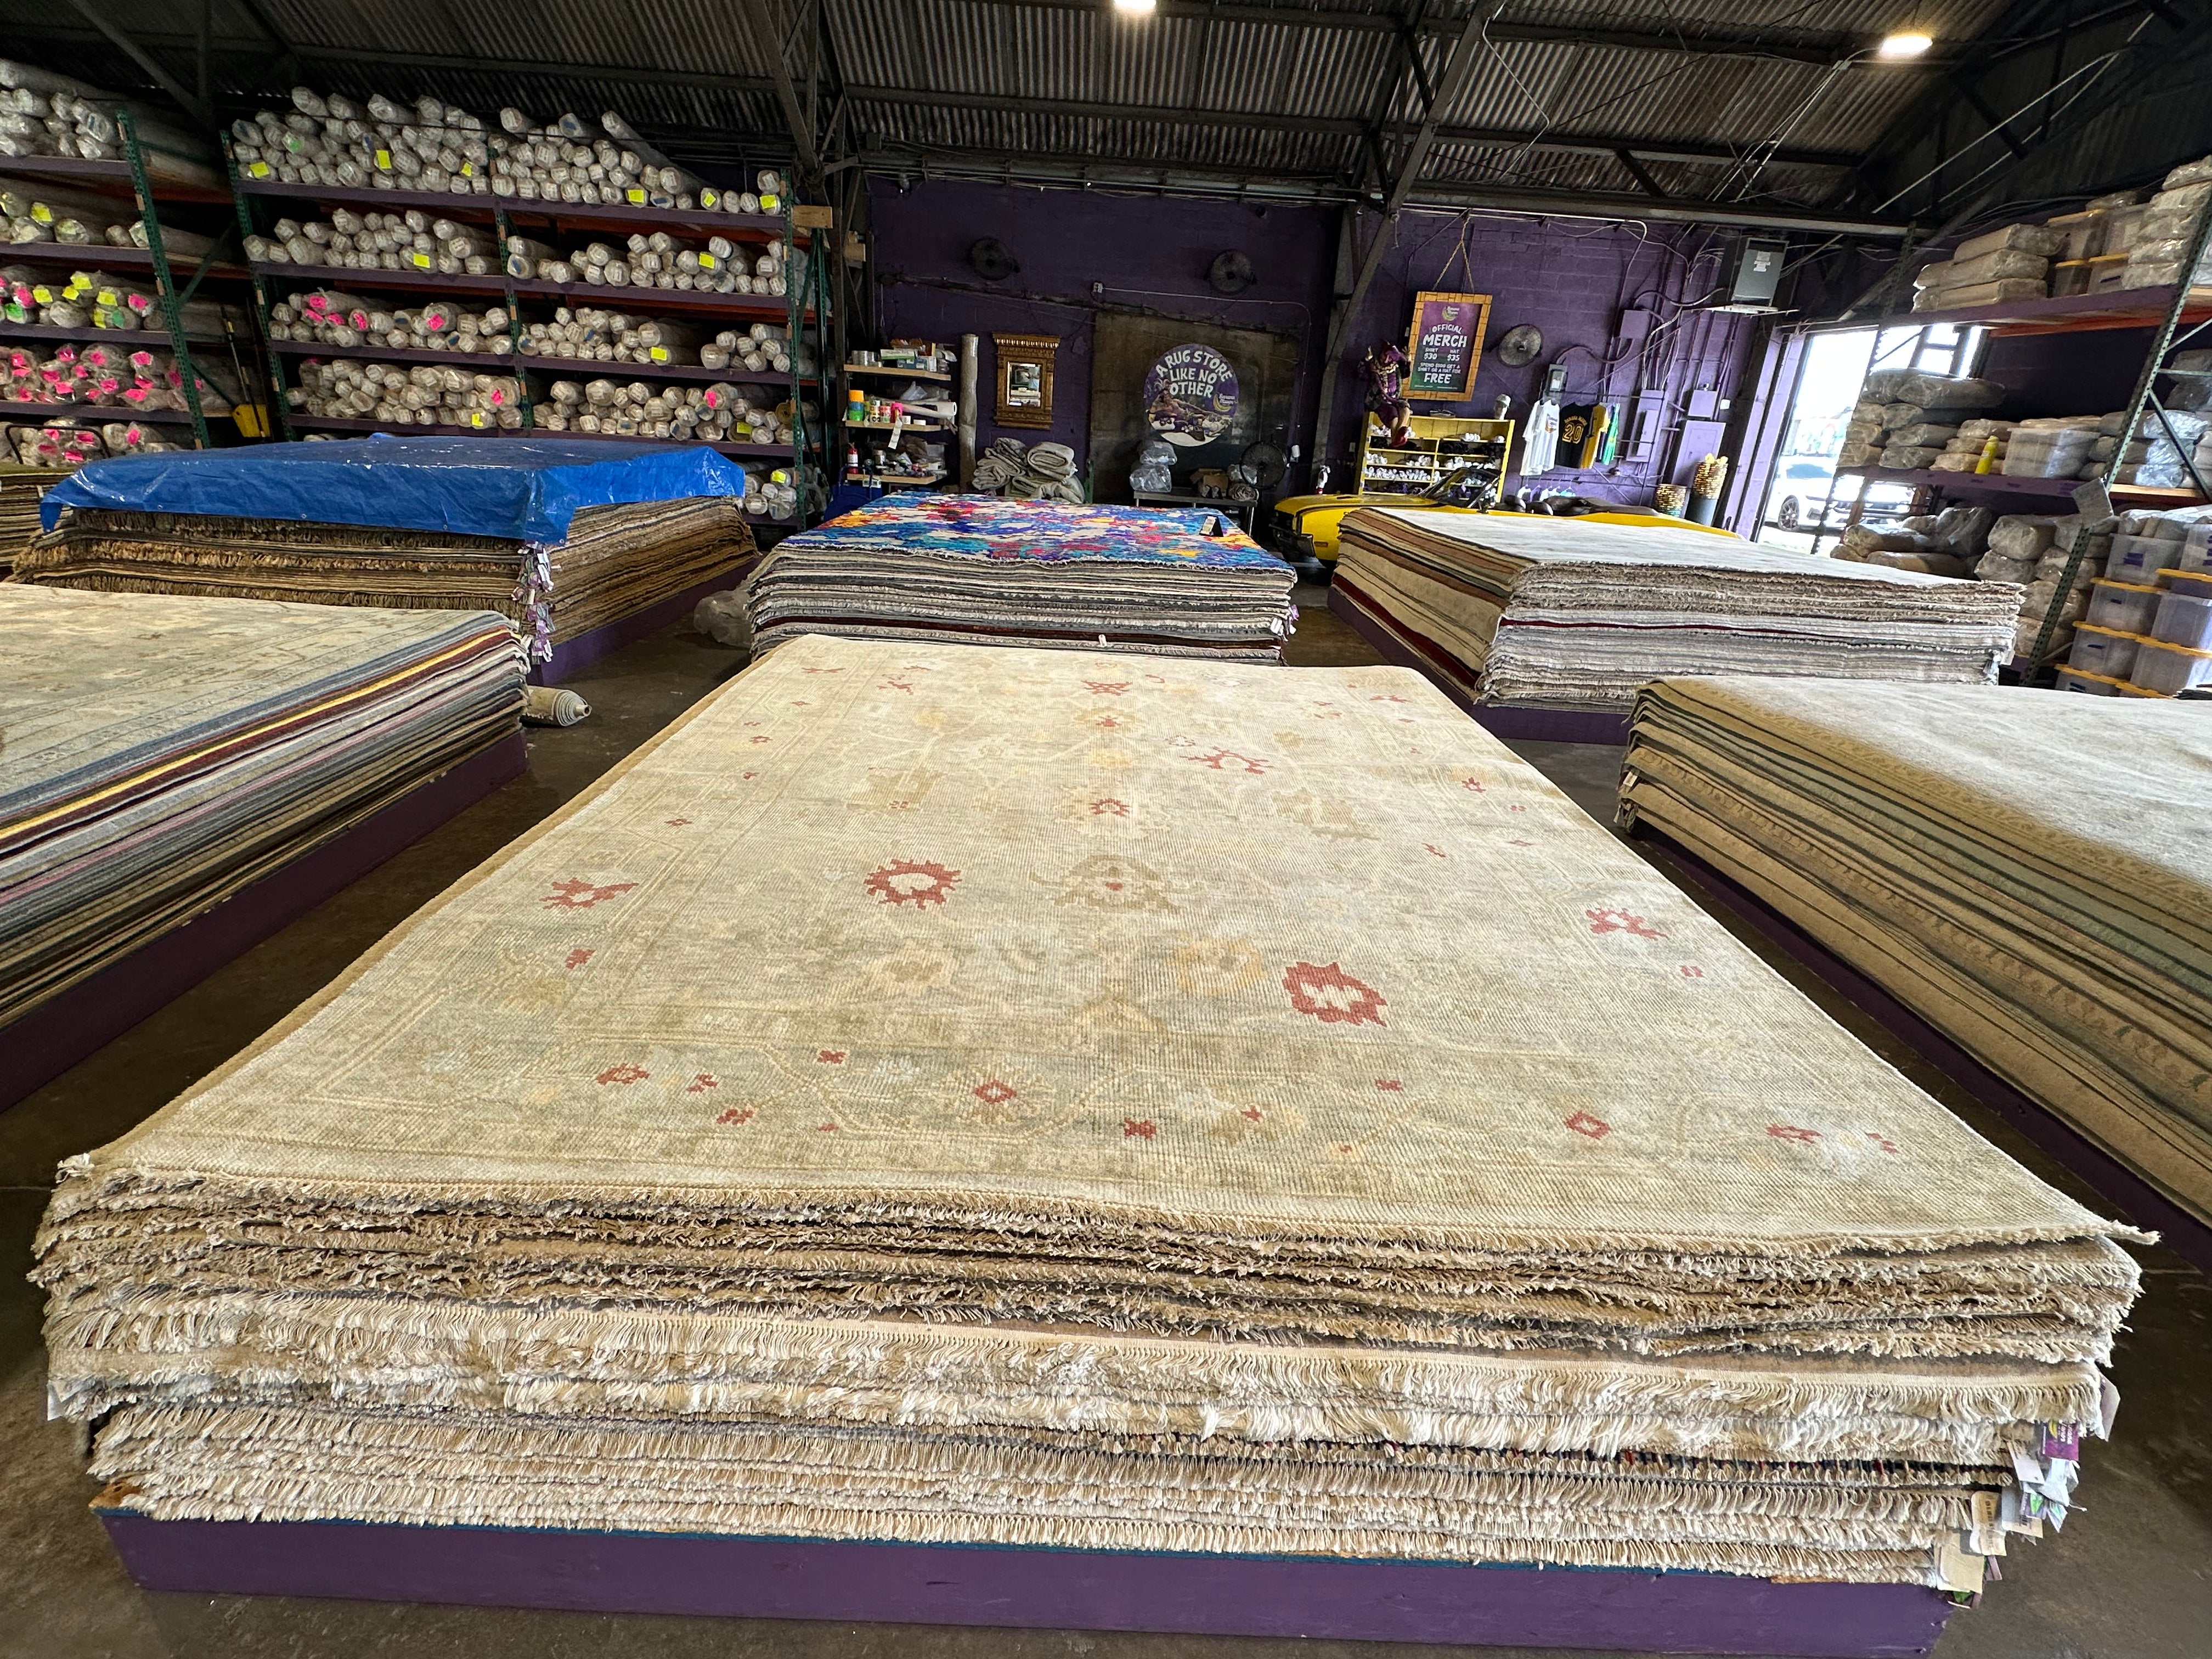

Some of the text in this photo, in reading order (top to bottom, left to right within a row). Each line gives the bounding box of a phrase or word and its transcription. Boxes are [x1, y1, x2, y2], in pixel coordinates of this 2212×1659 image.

[1432, 324, 1462, 334] OFFICIAL
[1423, 334, 1468, 347] MERCH
[1155, 350, 1233, 382] A RUG STORE
[1169, 368, 1217, 383] LIKE NO
[1424, 373, 1452, 383] FREE
[1169, 382, 1214, 397] OTHER
[1562, 422, 1584, 444] 20
